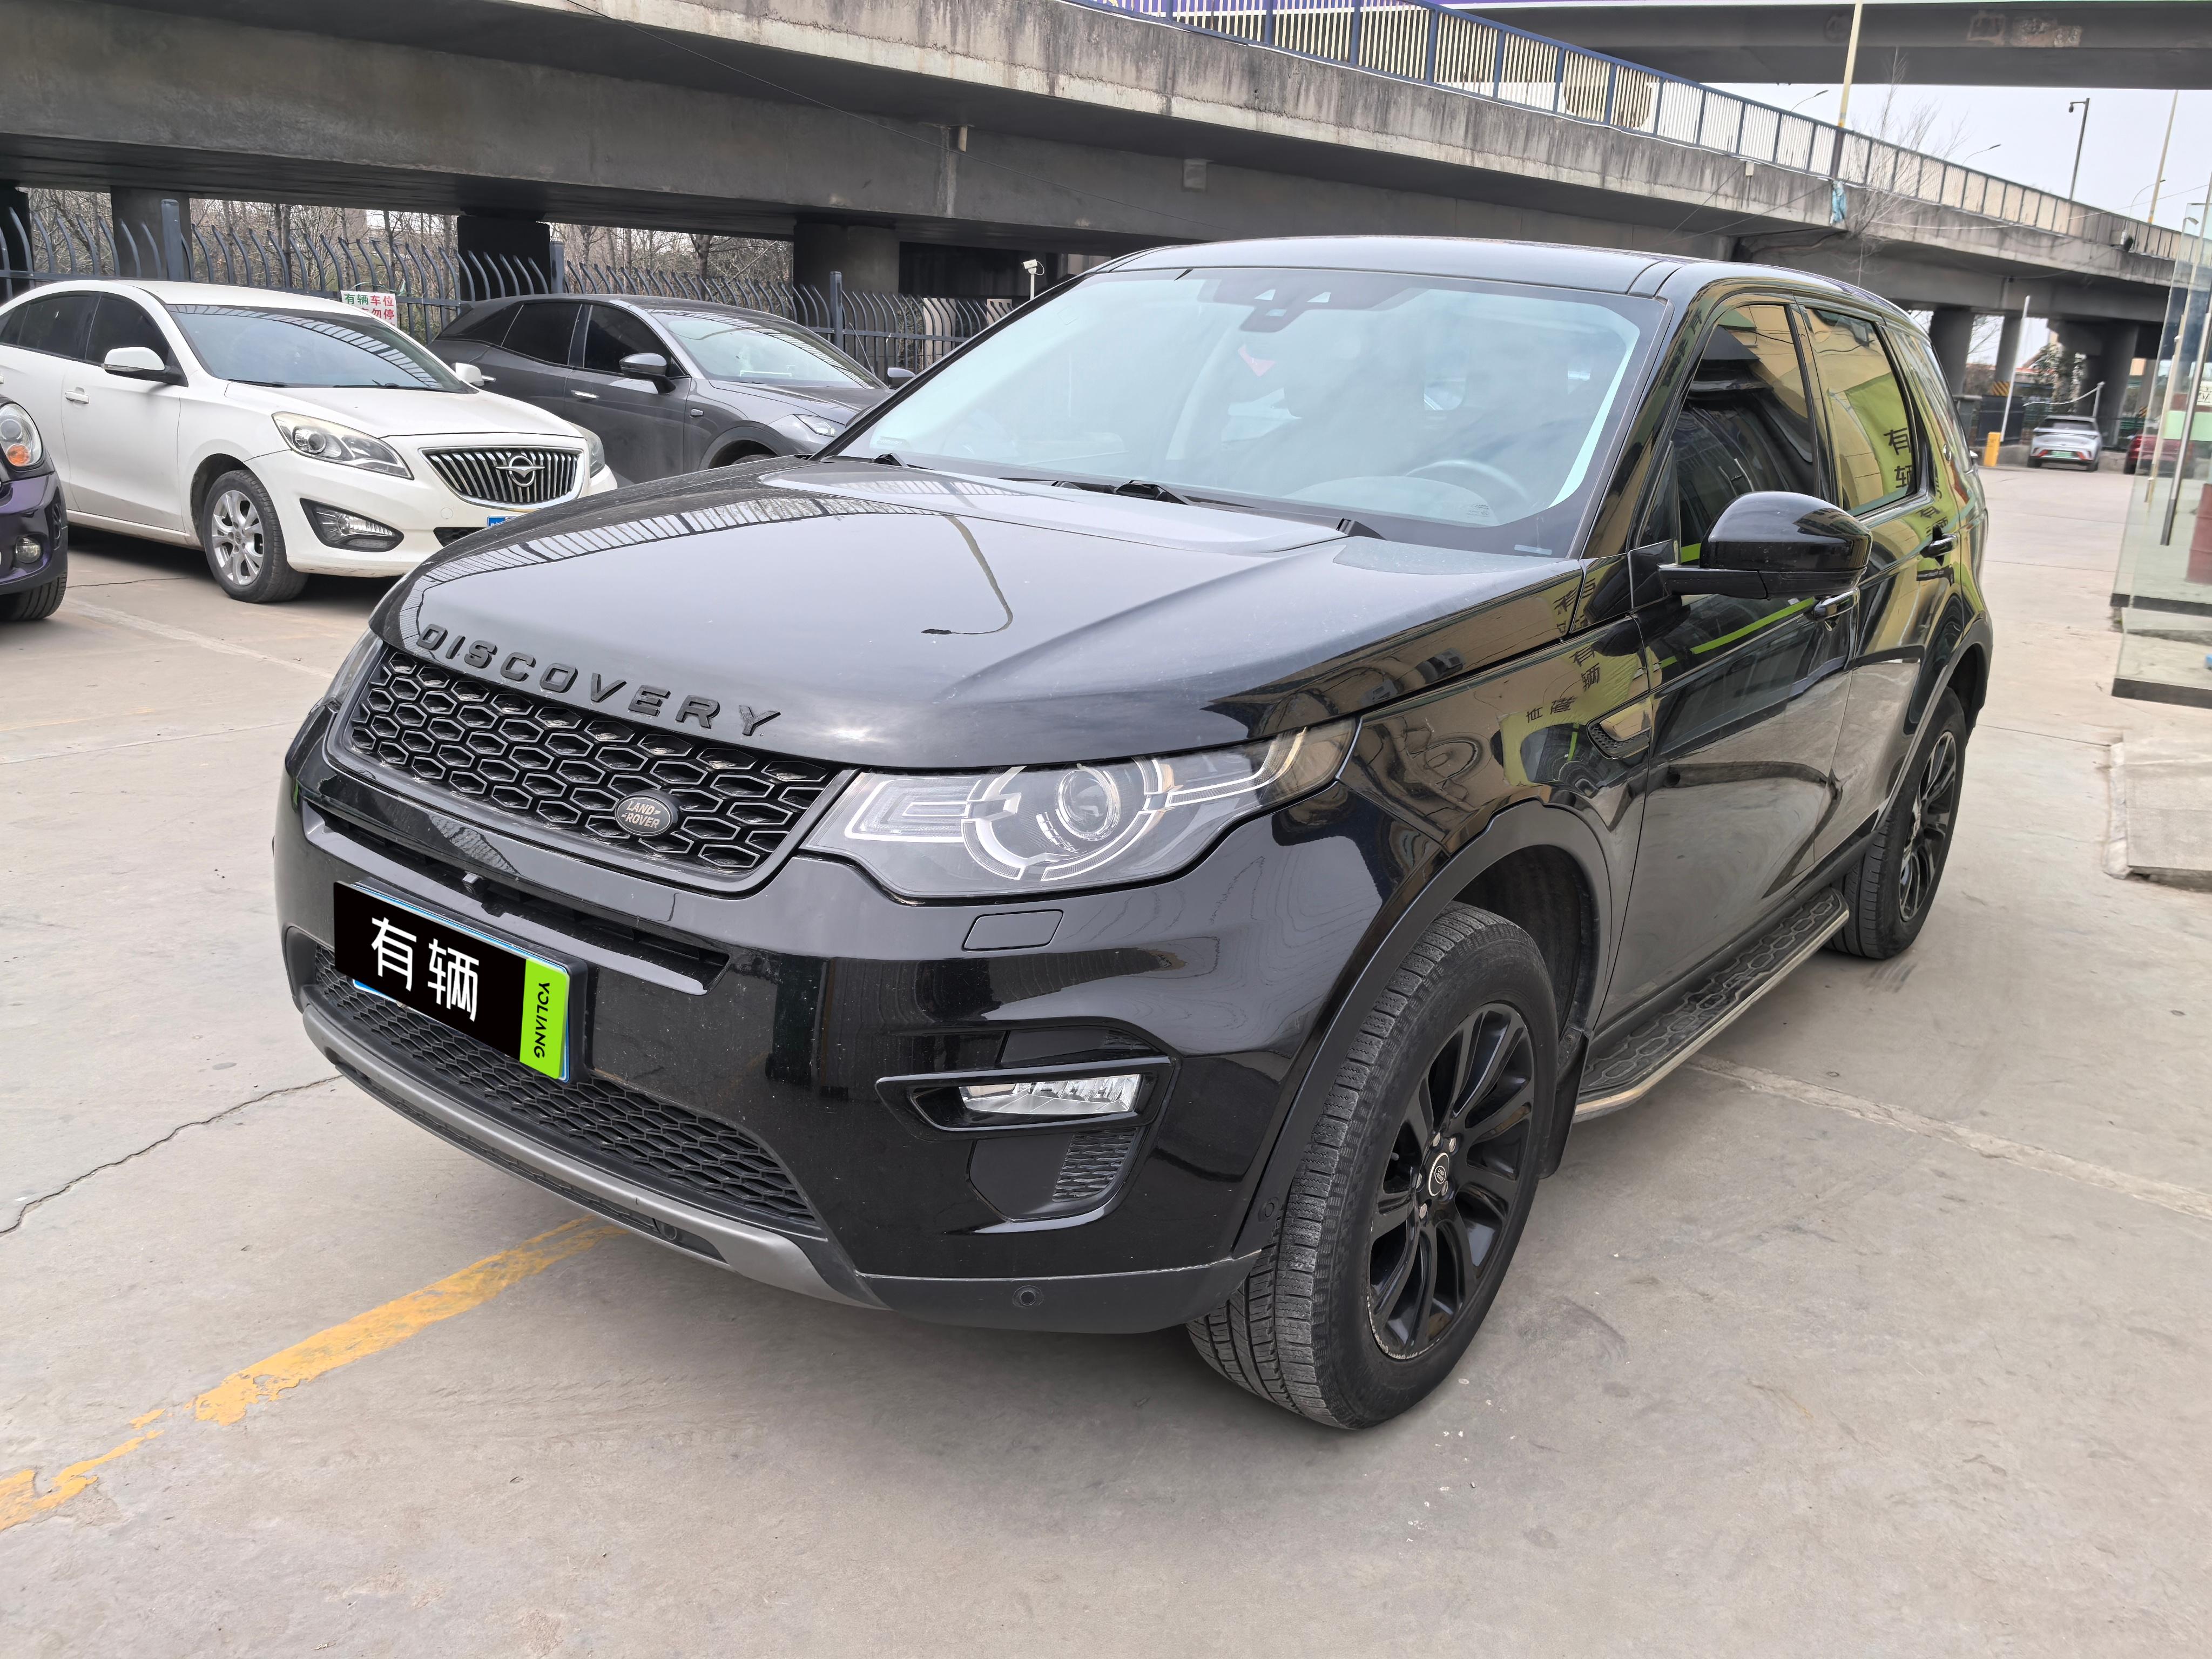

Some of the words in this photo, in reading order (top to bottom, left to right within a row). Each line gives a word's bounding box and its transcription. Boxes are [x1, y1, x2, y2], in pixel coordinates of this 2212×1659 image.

[344, 293, 394, 307] 有辆车位
[361, 307, 395, 320] 勿停
[416, 624, 781, 736] DISCOVERY
[626, 801, 655, 815] LAND
[625, 812, 660, 829] ROVER
